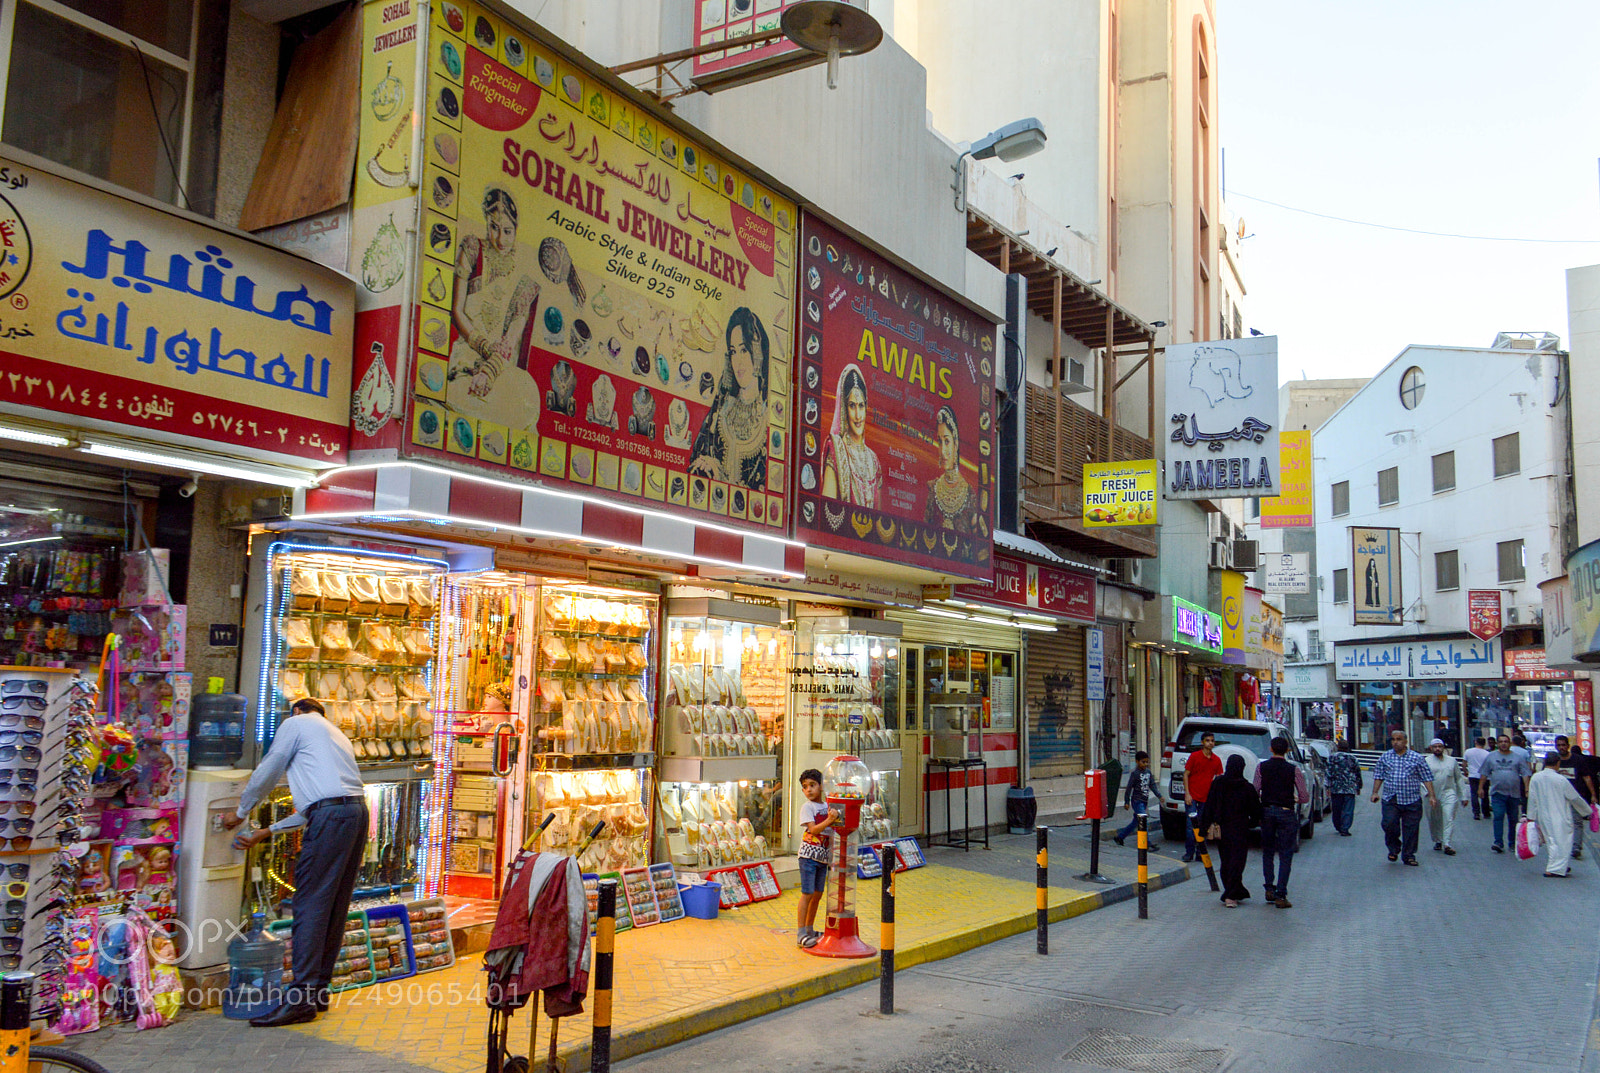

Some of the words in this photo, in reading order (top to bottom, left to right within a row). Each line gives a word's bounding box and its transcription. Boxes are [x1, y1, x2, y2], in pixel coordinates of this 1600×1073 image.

[382, 0, 410, 24] SOHAIL
[373, 24, 417, 53] JEWELLERY
[481, 64, 522, 94] Special
[469, 75, 528, 118] Ringmaker
[501, 137, 610, 224] SOHAIL
[616, 199, 750, 292] JEWELLERY
[744, 215, 769, 236] Special
[738, 226, 772, 253] Ringmaker
[547, 210, 596, 243] Arabic
[599, 233, 634, 263] Style
[636, 250, 648, 267] &
[652, 252, 691, 287] Indian
[692, 270, 722, 301] Style
[61, 229, 334, 335] مشير
[605, 258, 645, 285] Silver
[646, 277, 675, 299] 925
[857, 327, 953, 399] AWAIS
[1171, 413, 1272, 452] جميلة
[1102, 478, 1136, 491] FRESH
[1171, 456, 1272, 492] JAMEELA
[1280, 483, 1306, 493] HIJAB
[1086, 492, 1117, 505] FRUIT
[1121, 490, 1154, 502] JUICE
[1263, 498, 1277, 506] AL
[1277, 497, 1309, 506] ABYAD
[995, 573, 1020, 593] JUICE
[1342, 646, 1401, 672] للعباءات
[1420, 642, 1494, 669] الخواجة
